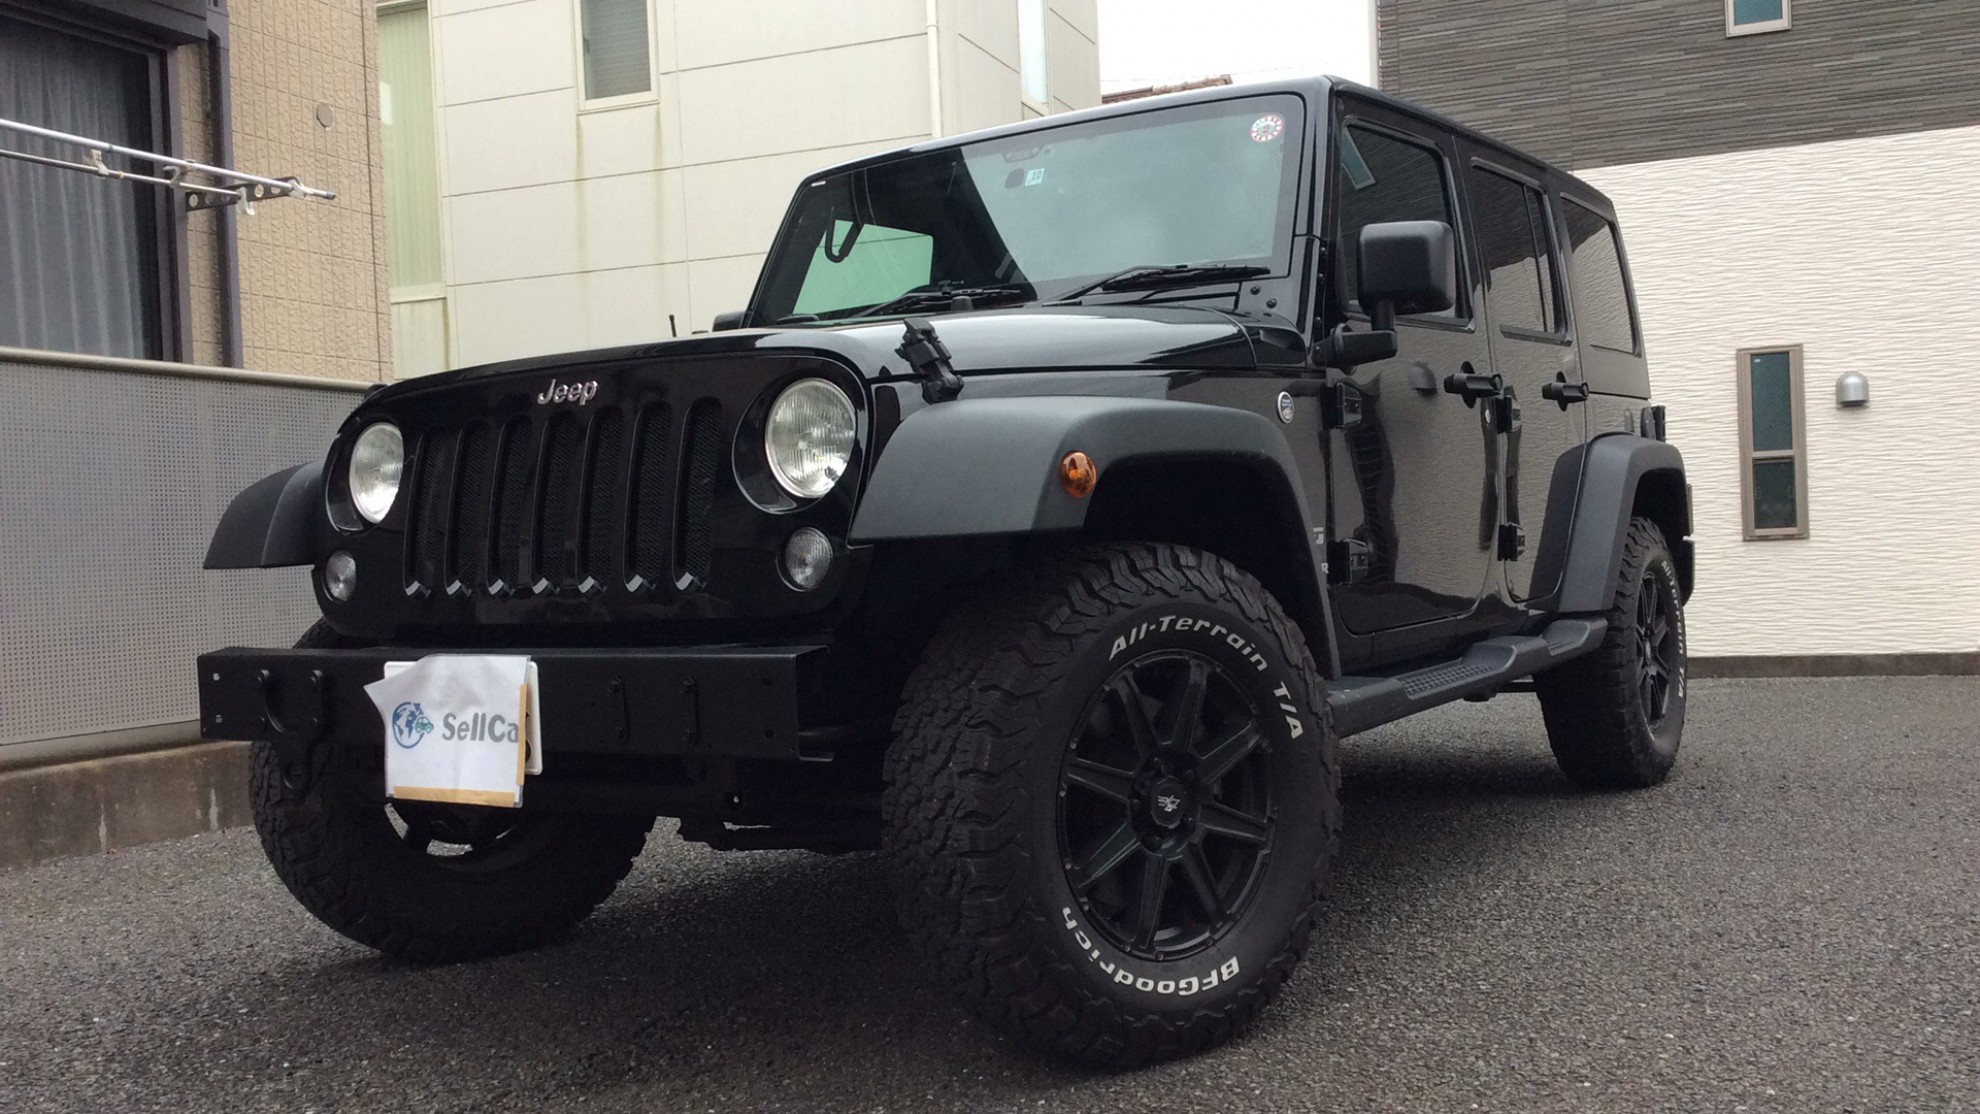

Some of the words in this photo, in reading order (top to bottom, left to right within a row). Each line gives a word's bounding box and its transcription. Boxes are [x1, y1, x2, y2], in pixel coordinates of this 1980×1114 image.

[537, 379, 598, 406] Jeep
[1109, 615, 1268, 672] All-Terrain
[1273, 681, 1304, 740] T/A
[441, 712, 519, 743] SellCa
[1062, 907, 1240, 996] BFGoodrich
